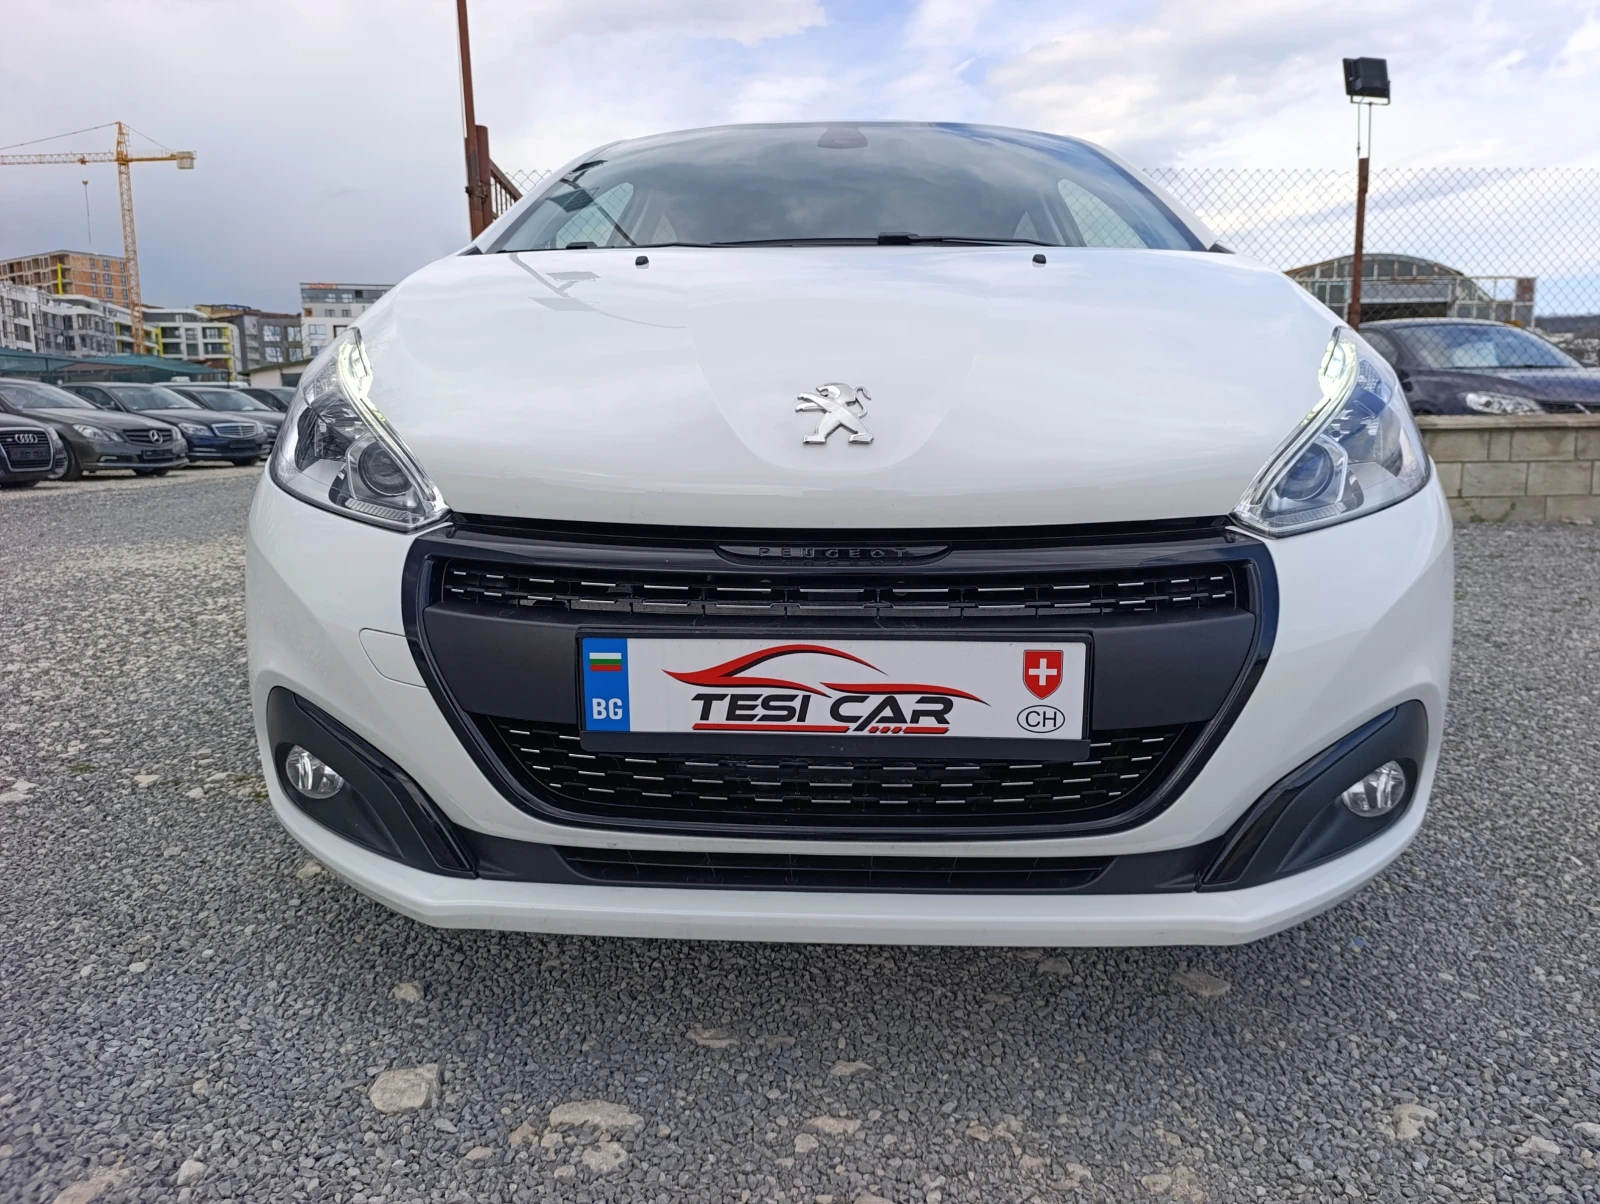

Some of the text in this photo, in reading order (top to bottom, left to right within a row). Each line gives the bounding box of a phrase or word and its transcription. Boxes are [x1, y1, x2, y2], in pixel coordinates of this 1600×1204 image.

[758, 547, 906, 558] PEUGEOT
[592, 698, 623, 720] BG
[691, 693, 953, 731] TESI CAR
[1024, 710, 1060, 729] CH
